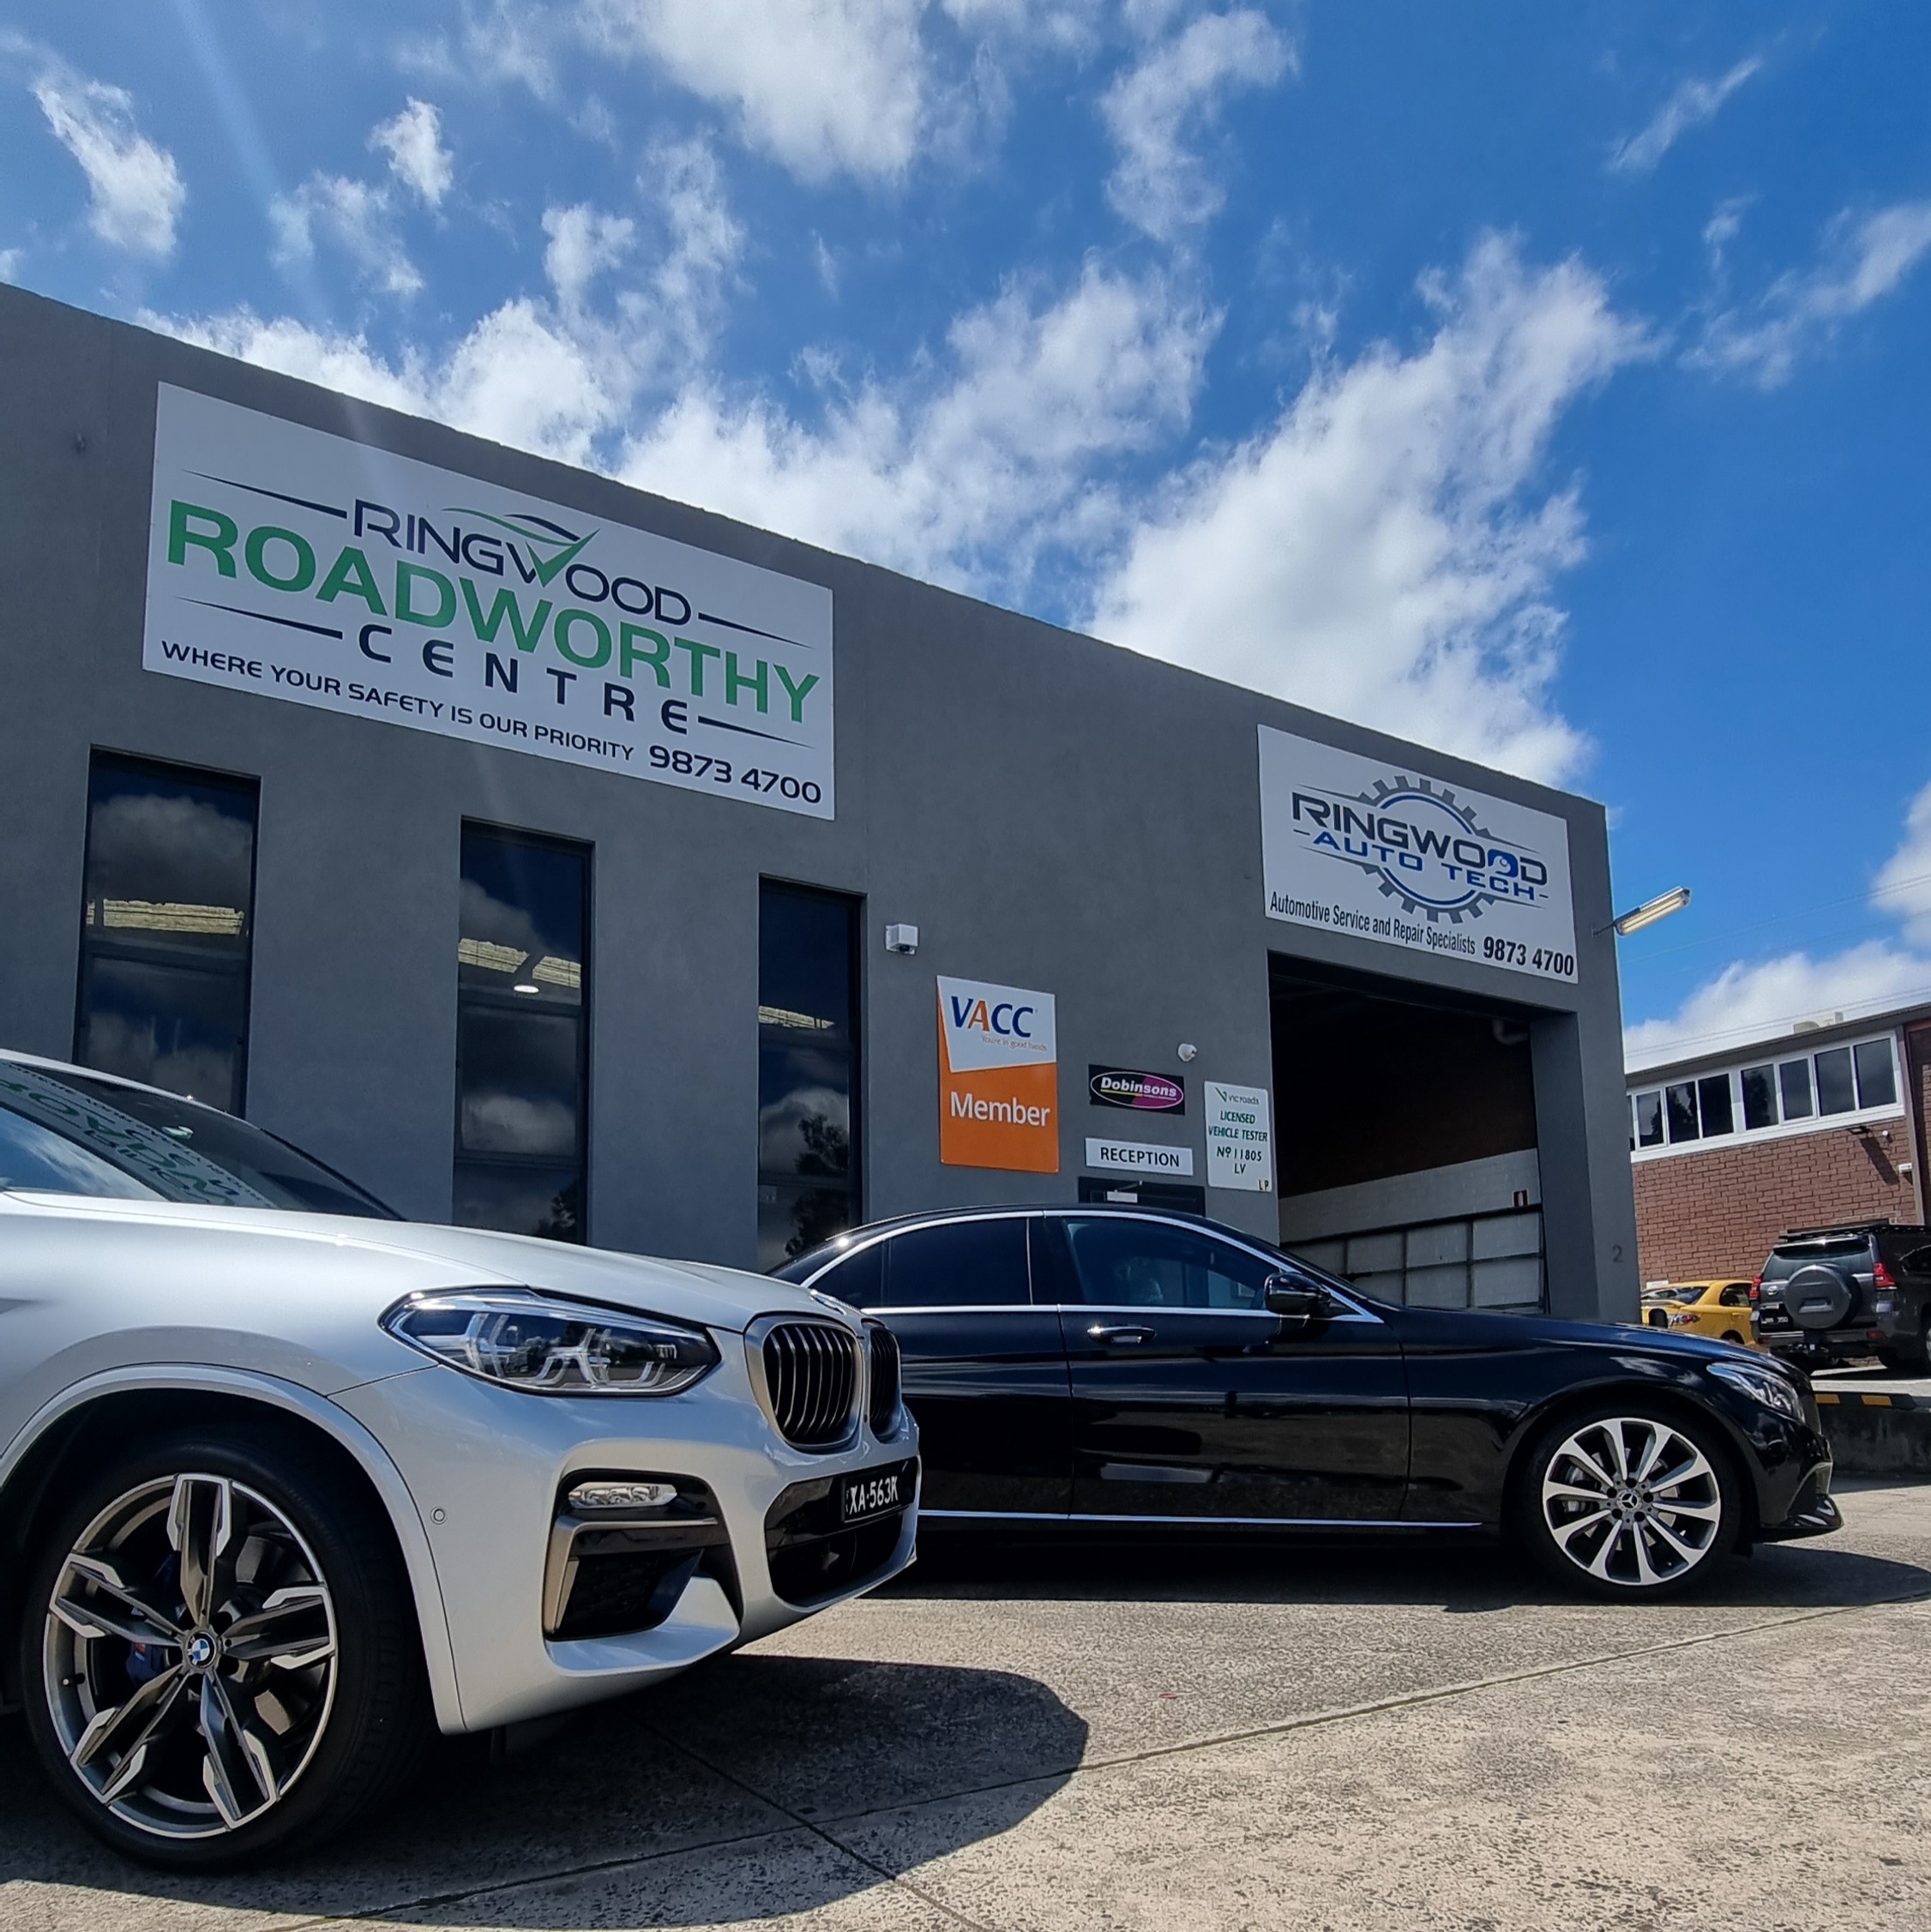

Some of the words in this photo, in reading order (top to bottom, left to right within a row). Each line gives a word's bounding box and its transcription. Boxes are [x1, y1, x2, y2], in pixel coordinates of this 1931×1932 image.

[354, 499, 691, 624] RINGWOOD
[167, 500, 820, 723] ROADWORTHY
[358, 623, 688, 733] CENTRE
[161, 641, 263, 676] WHERE
[270, 665, 341, 695] YOUR
[348, 683, 444, 718] SAFETY
[451, 705, 473, 725] IS
[479, 713, 528, 737] OUR
[534, 725, 635, 761] PRIORITY
[649, 744, 732, 784] 9873
[741, 767, 821, 804] 4700
[1291, 791, 1548, 886] RINGWOOD
[1313, 831, 1423, 871] AUTO
[1441, 863, 1535, 900] TECH
[1270, 890, 1330, 924] Automotive
[1332, 905, 1370, 932] Service
[1372, 915, 1391, 936] and
[1393, 919, 1424, 944] Repair
[1426, 926, 1476, 955] Specialists
[1483, 936, 1526, 966] 9873
[1531, 951, 1574, 977] 4700
[951, 996, 1034, 1038] VACC
[1010, 1040, 1027, 1050] good
[1100, 1077, 1177, 1098] Dobinsons
[950, 1091, 1050, 1128] Member
[1220, 1110, 1255, 1124] LICENSED
[1208, 1125, 1239, 1140] VEHICLE
[1242, 1129, 1268, 1142] TESTER
[1100, 1147, 1180, 1167] RECEPTION
[1234, 1147, 1262, 1162] 11805
[1234, 1163, 1246, 1175] LV
[1612, 1246, 1623, 1263] 2
